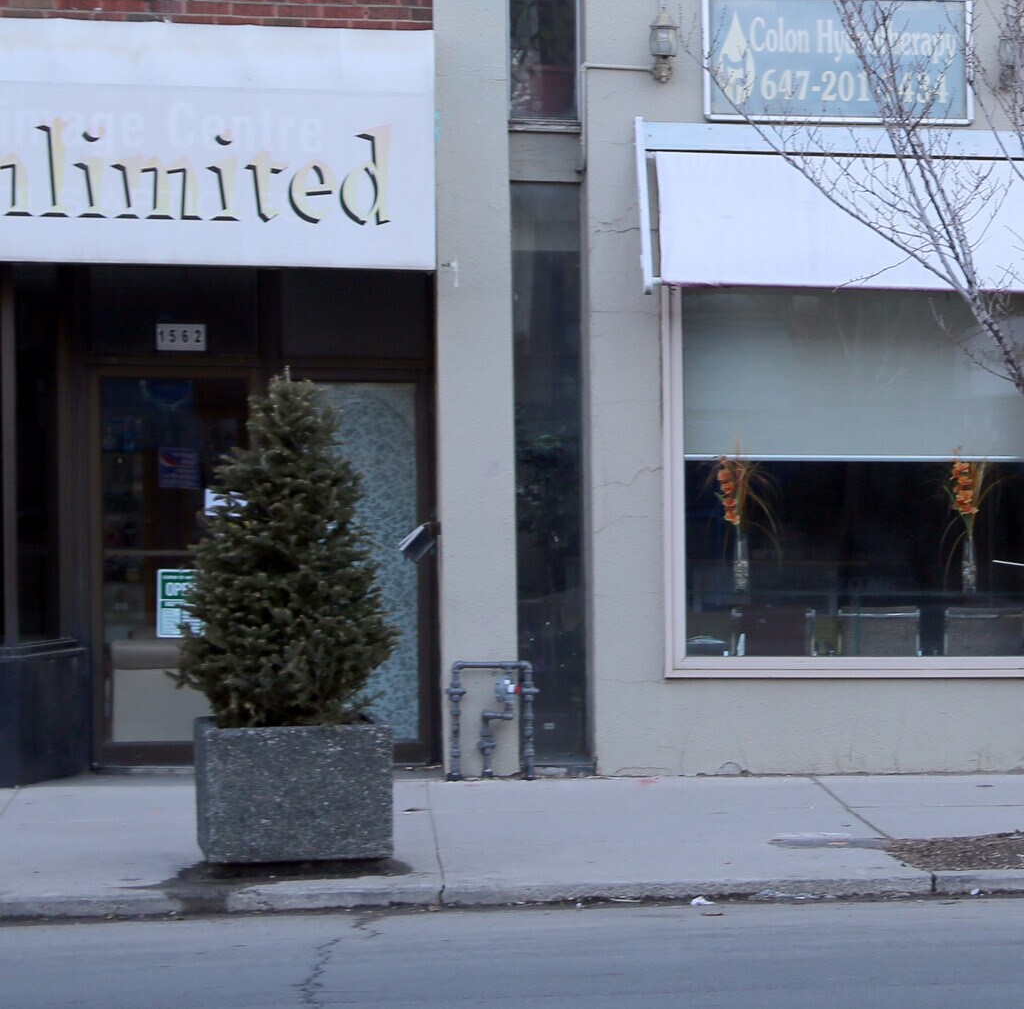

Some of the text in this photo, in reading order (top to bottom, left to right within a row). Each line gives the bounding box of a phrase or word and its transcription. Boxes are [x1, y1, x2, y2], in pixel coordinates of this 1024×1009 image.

[749, 17, 957, 64] Colon Hyotherapy
[760, 69, 949, 104] 647-201-434
[158, 329, 202, 344] 1562
